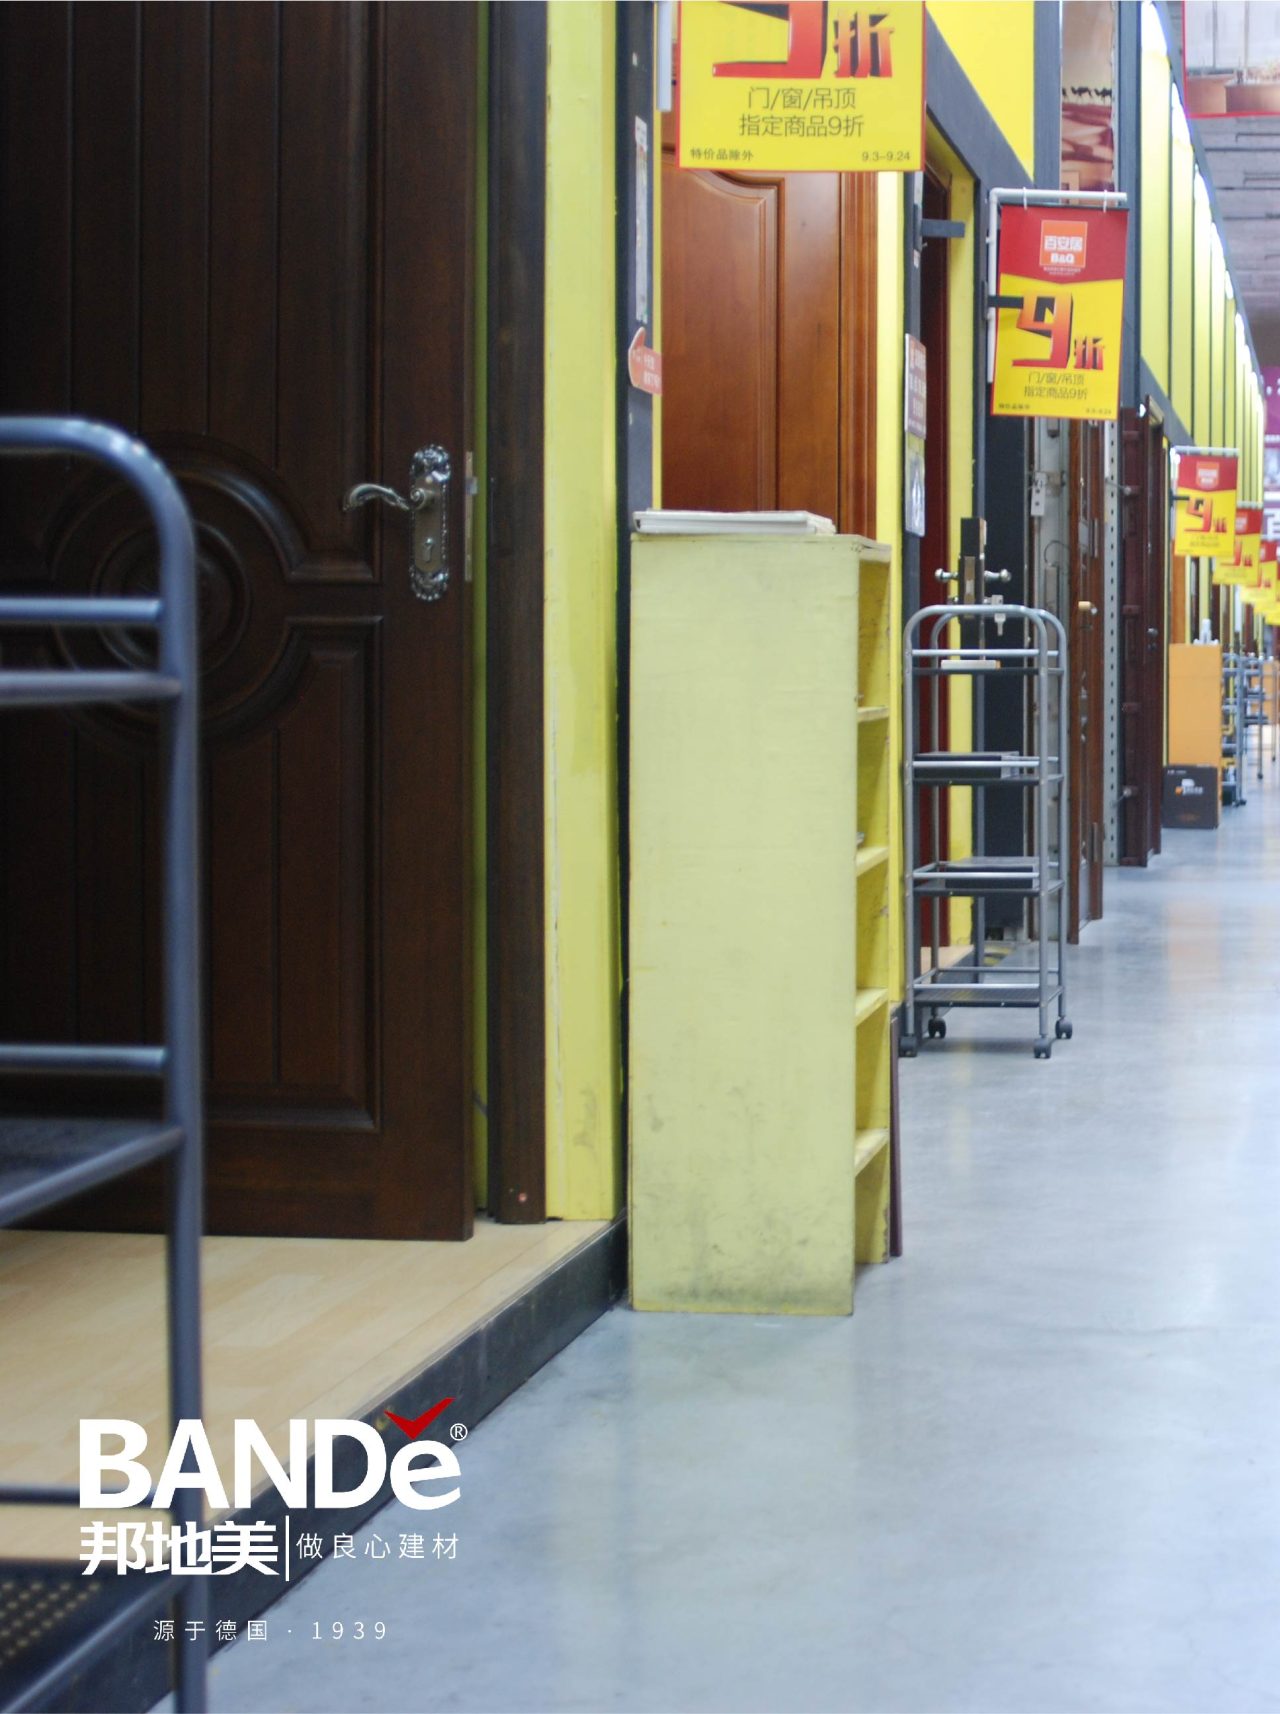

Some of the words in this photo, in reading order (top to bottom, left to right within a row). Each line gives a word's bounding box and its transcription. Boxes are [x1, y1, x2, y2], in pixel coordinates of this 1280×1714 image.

[748, 86, 857, 111] 门/窗/吊顶
[739, 114, 865, 138] 指定商品9折
[690, 148, 754, 161] 特价品除外
